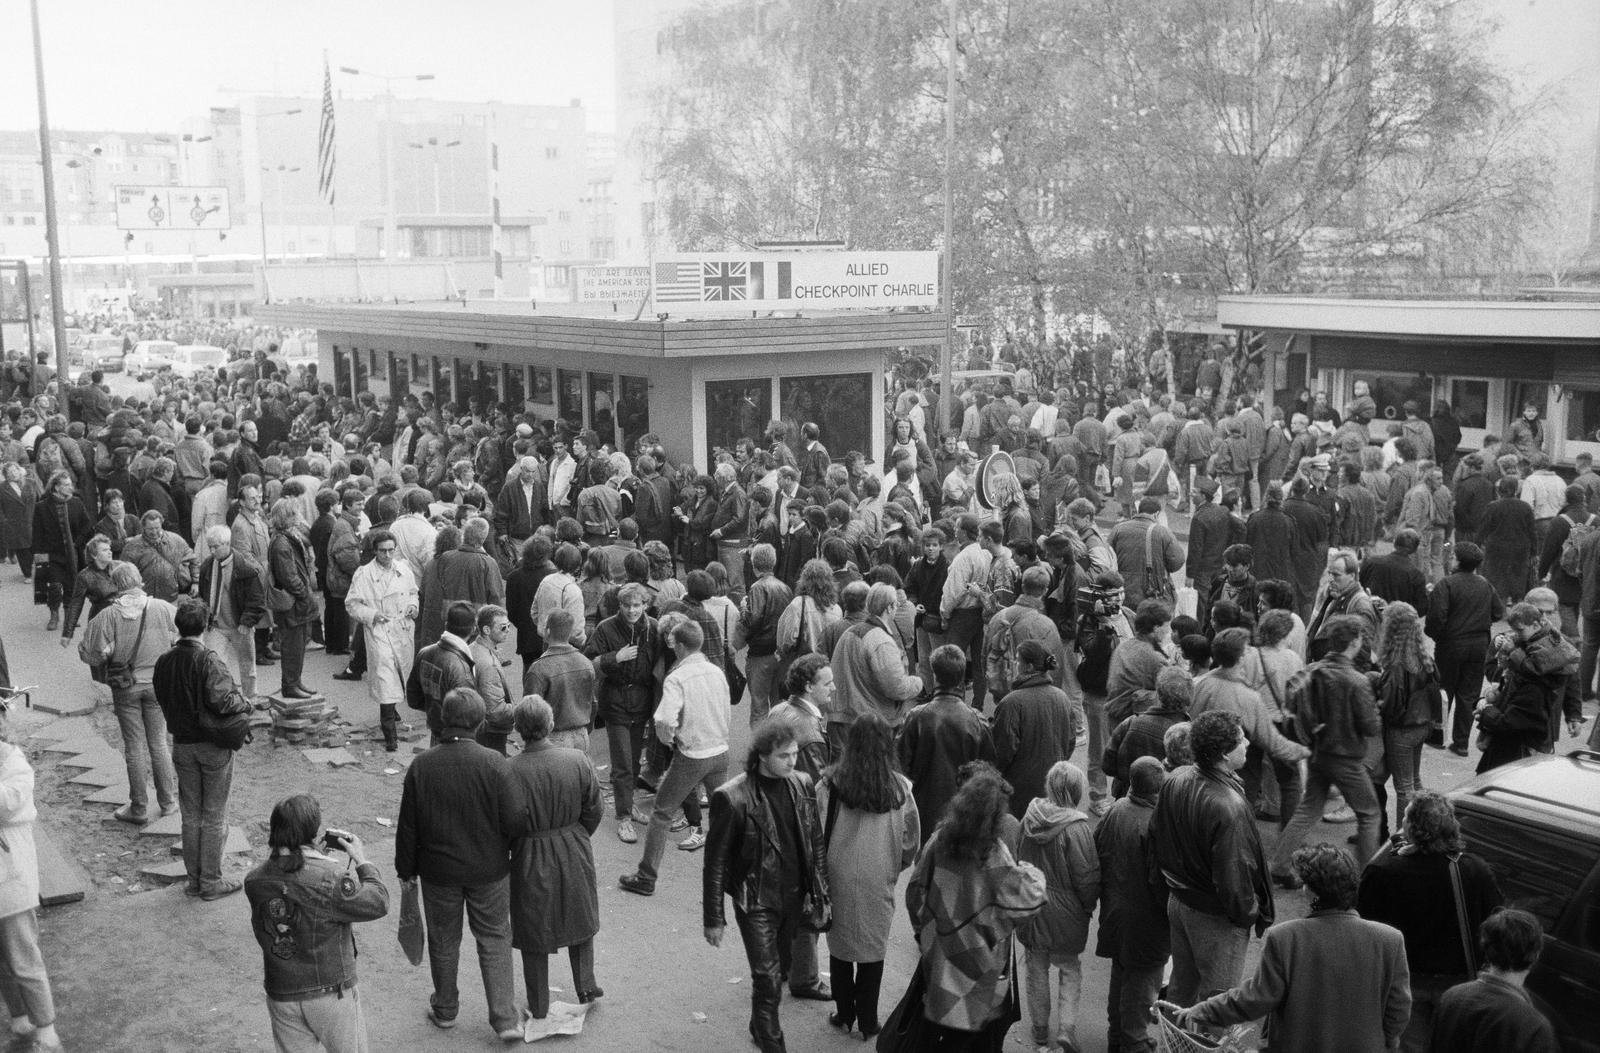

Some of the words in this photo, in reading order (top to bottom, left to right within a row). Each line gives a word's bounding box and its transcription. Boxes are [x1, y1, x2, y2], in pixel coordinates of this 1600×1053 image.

[585, 268, 602, 277] YOU
[606, 268, 620, 277] ARE
[846, 263, 889, 276] ALLIED
[583, 278, 595, 287] THE
[598, 278, 632, 287] AMERICAN
[795, 284, 878, 299] CHECKPOINT
[882, 283, 935, 297] CHARLIE
